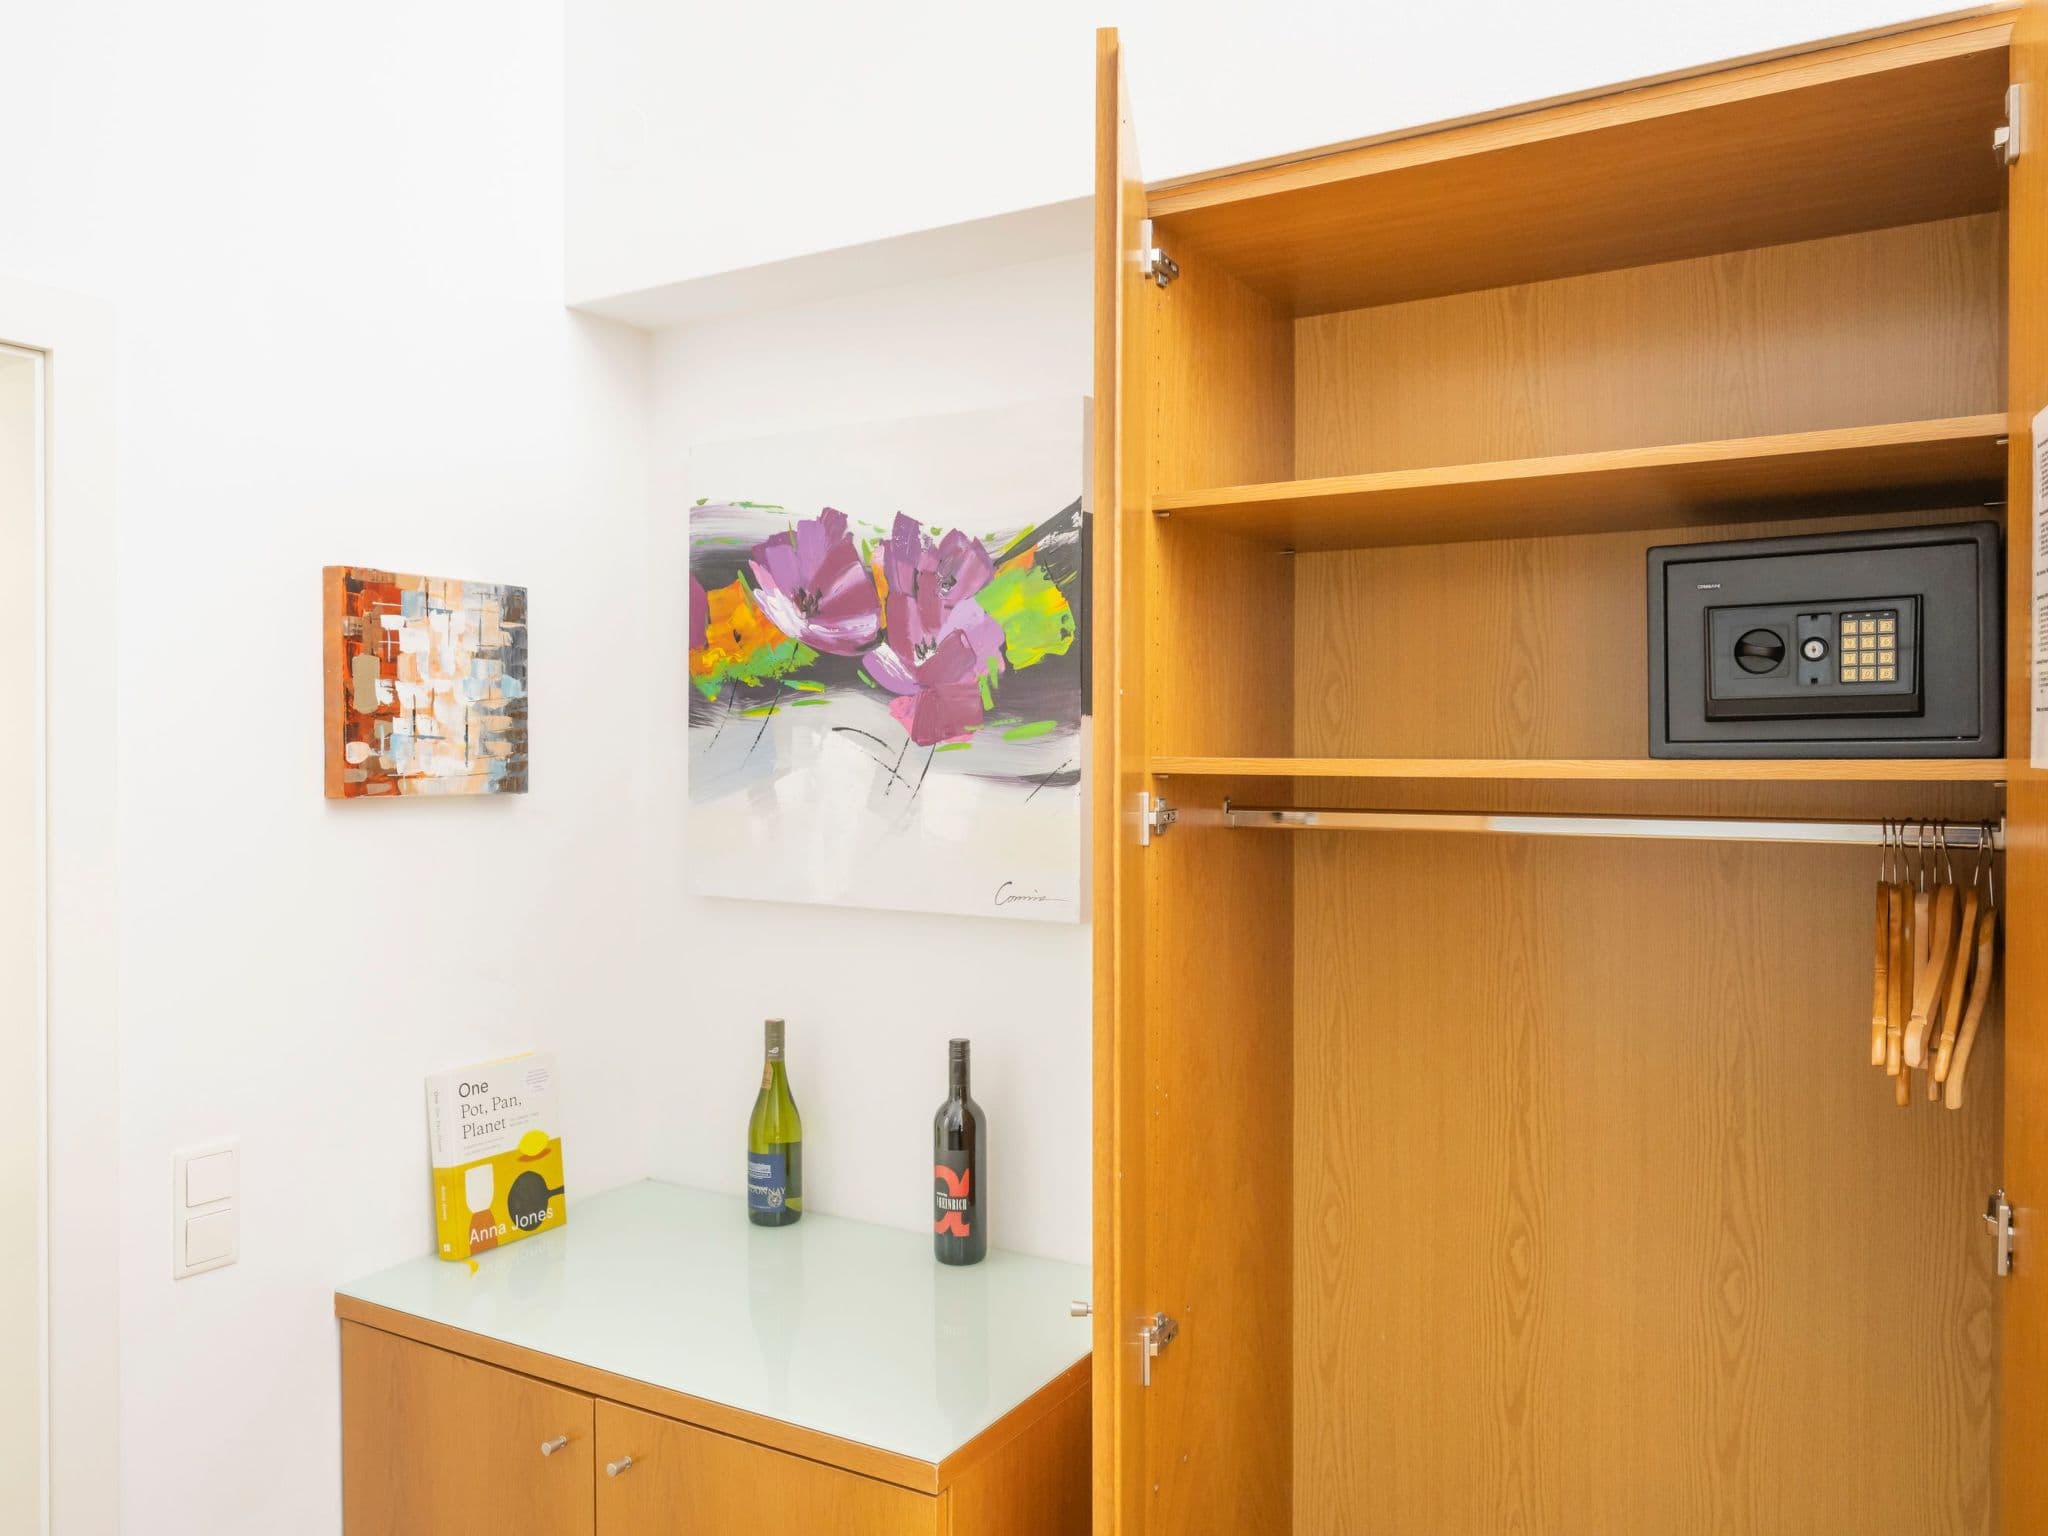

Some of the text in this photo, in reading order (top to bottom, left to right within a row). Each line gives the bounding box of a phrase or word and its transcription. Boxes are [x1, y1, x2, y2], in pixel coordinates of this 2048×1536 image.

[458, 1081, 489, 1098] One
[460, 1095, 523, 1119] Pot, Pan,
[462, 1118, 507, 1140] Planet
[469, 1207, 554, 1245] Anna Jones
